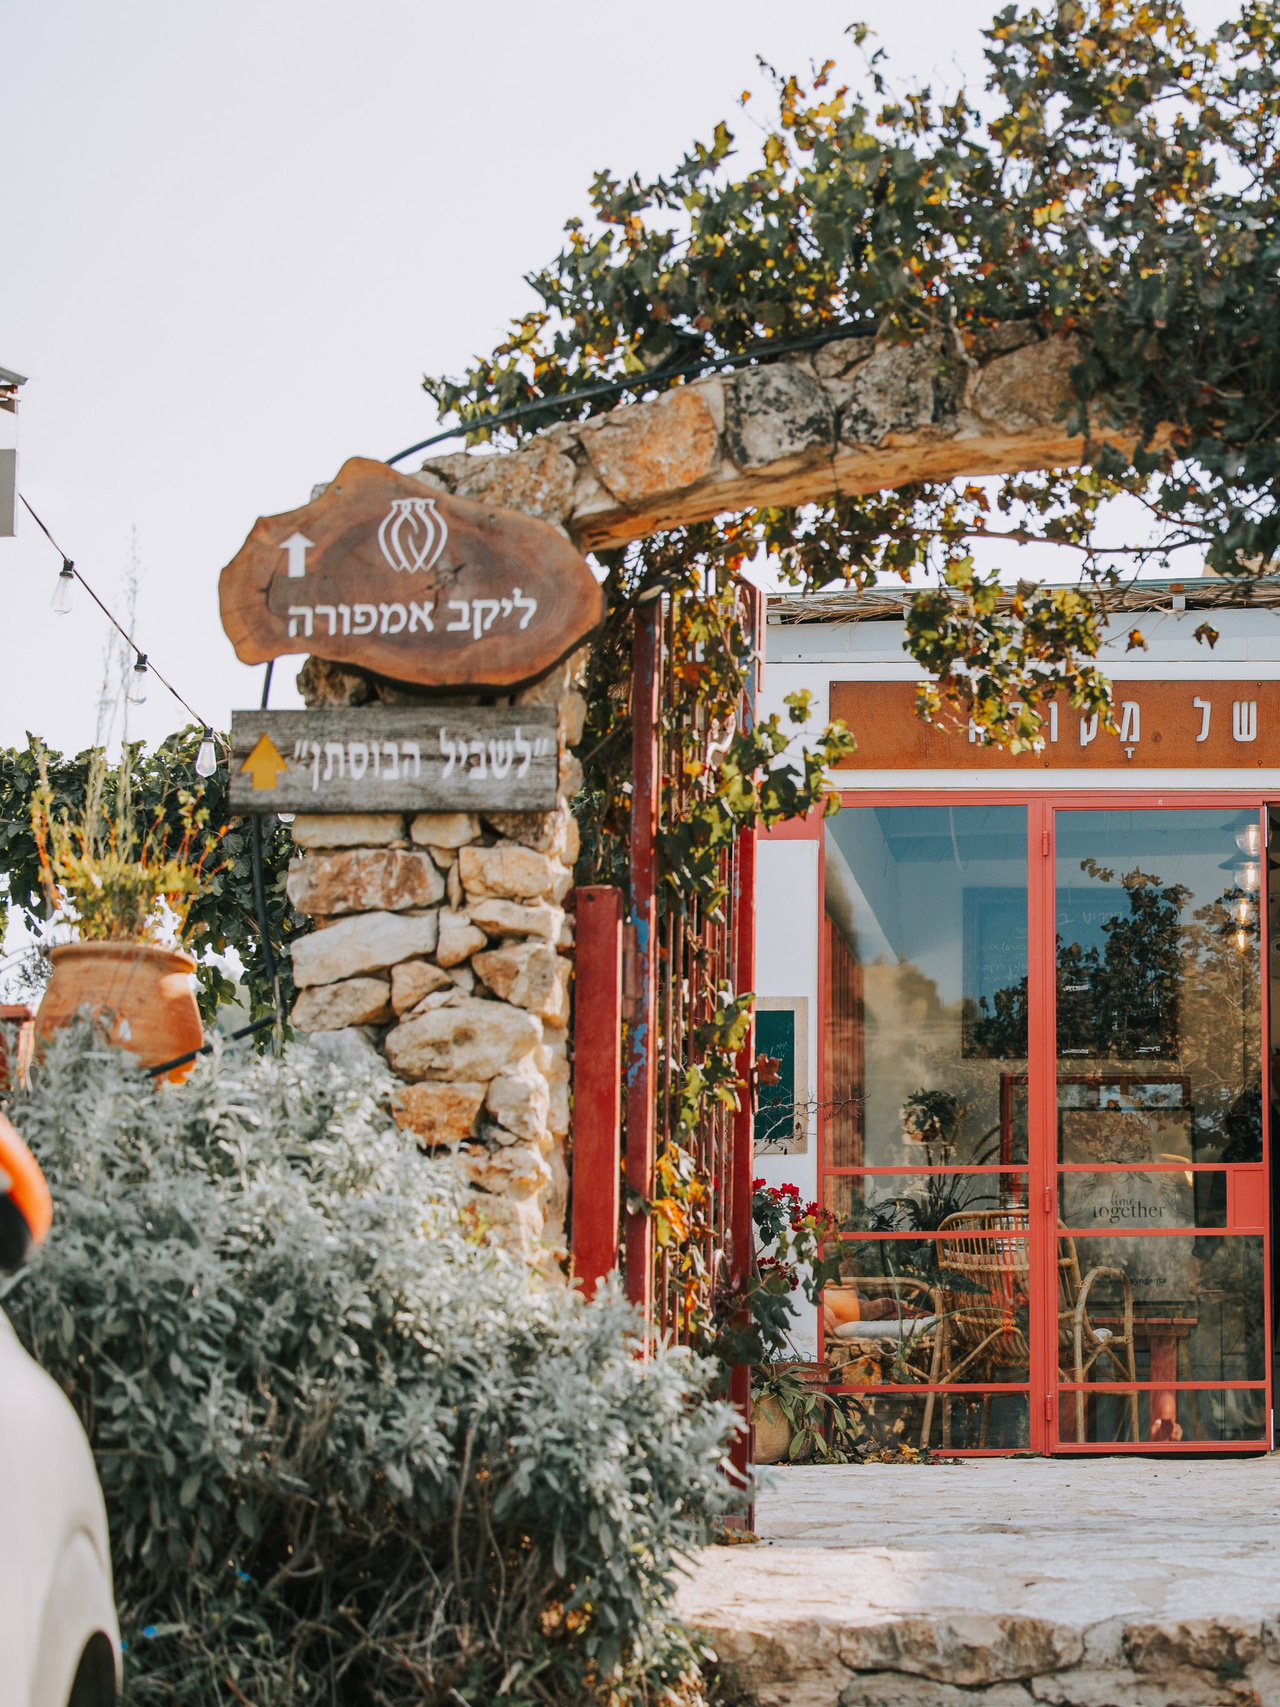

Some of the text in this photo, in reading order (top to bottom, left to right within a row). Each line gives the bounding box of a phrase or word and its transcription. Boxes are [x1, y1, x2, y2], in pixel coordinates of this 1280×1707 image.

[288, 586, 538, 640] ליקב אמפורה
[1193, 696, 1257, 742] של
[1092, 1201, 1166, 1224] together
[1130, 1276, 1167, 1286] syngenta
